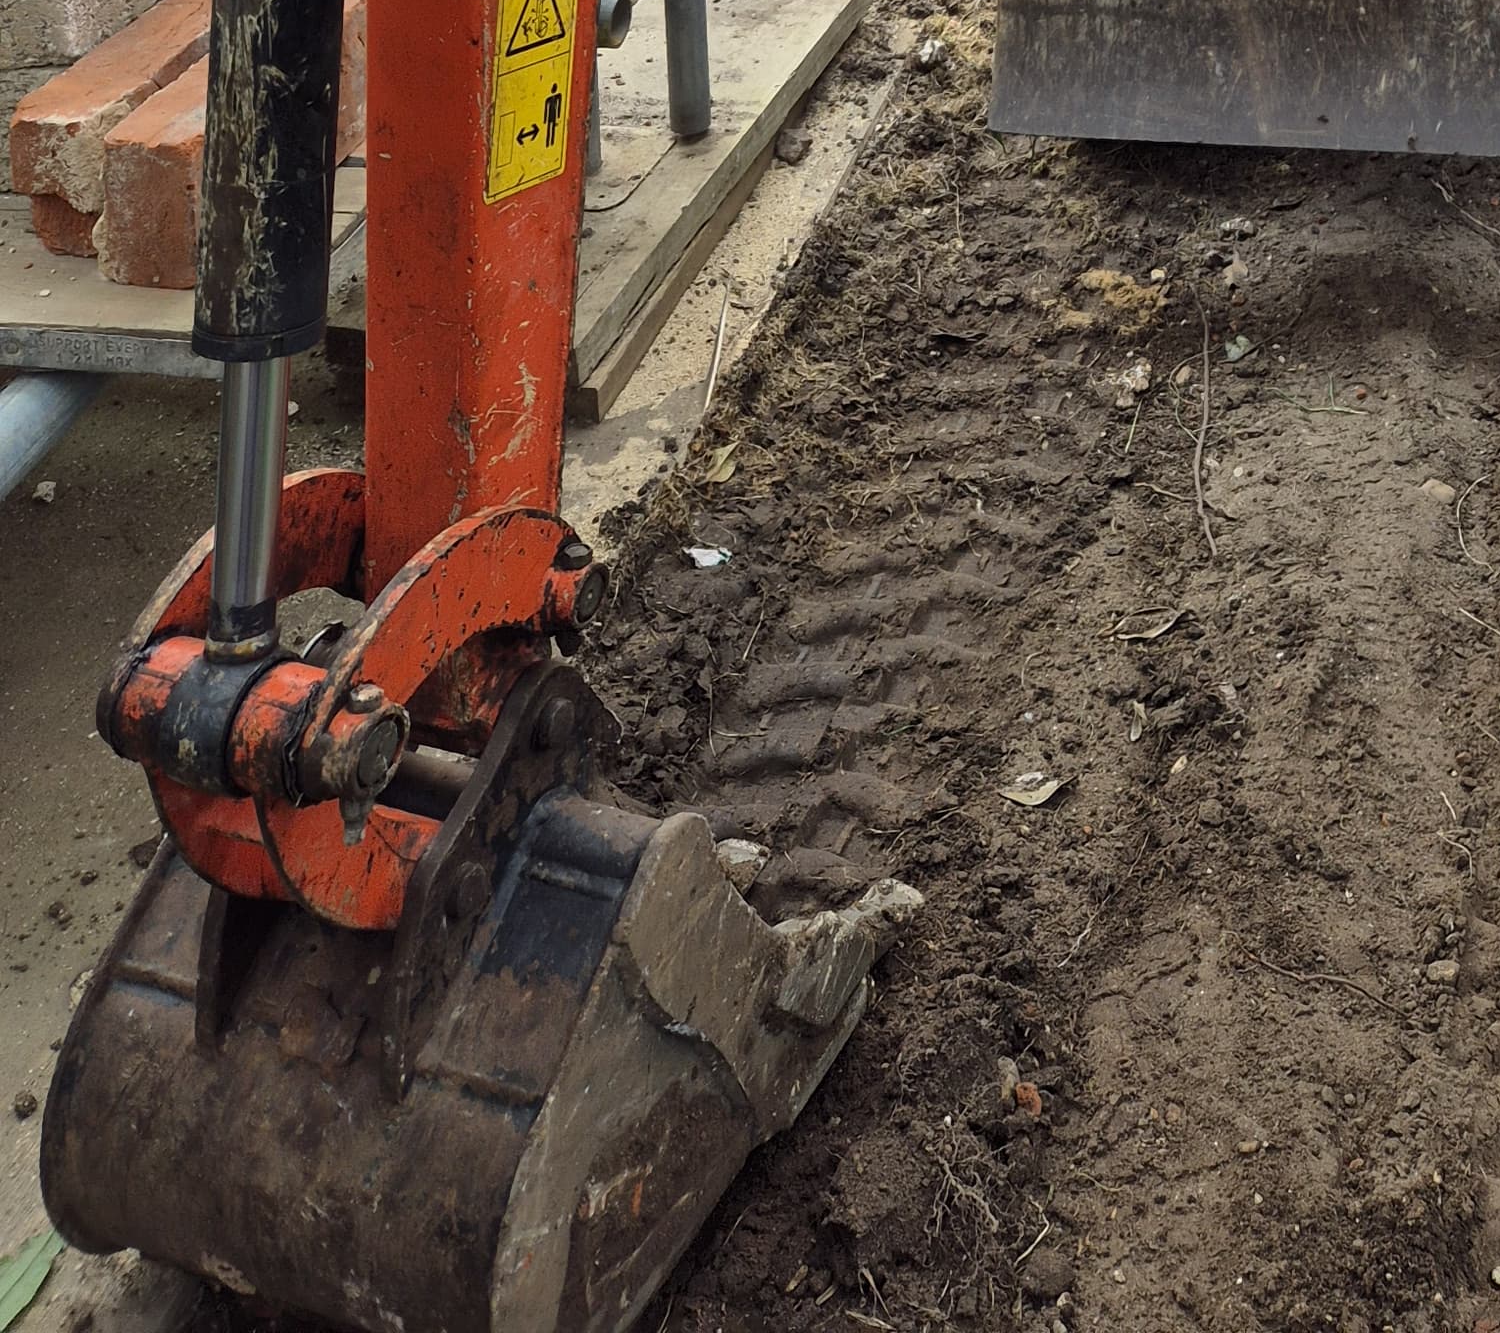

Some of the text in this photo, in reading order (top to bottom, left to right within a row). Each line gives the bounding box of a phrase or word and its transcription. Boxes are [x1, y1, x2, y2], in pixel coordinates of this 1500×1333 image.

[39, 336, 149, 355] SUPPORT EVERY
[105, 356, 134, 367] MAX
